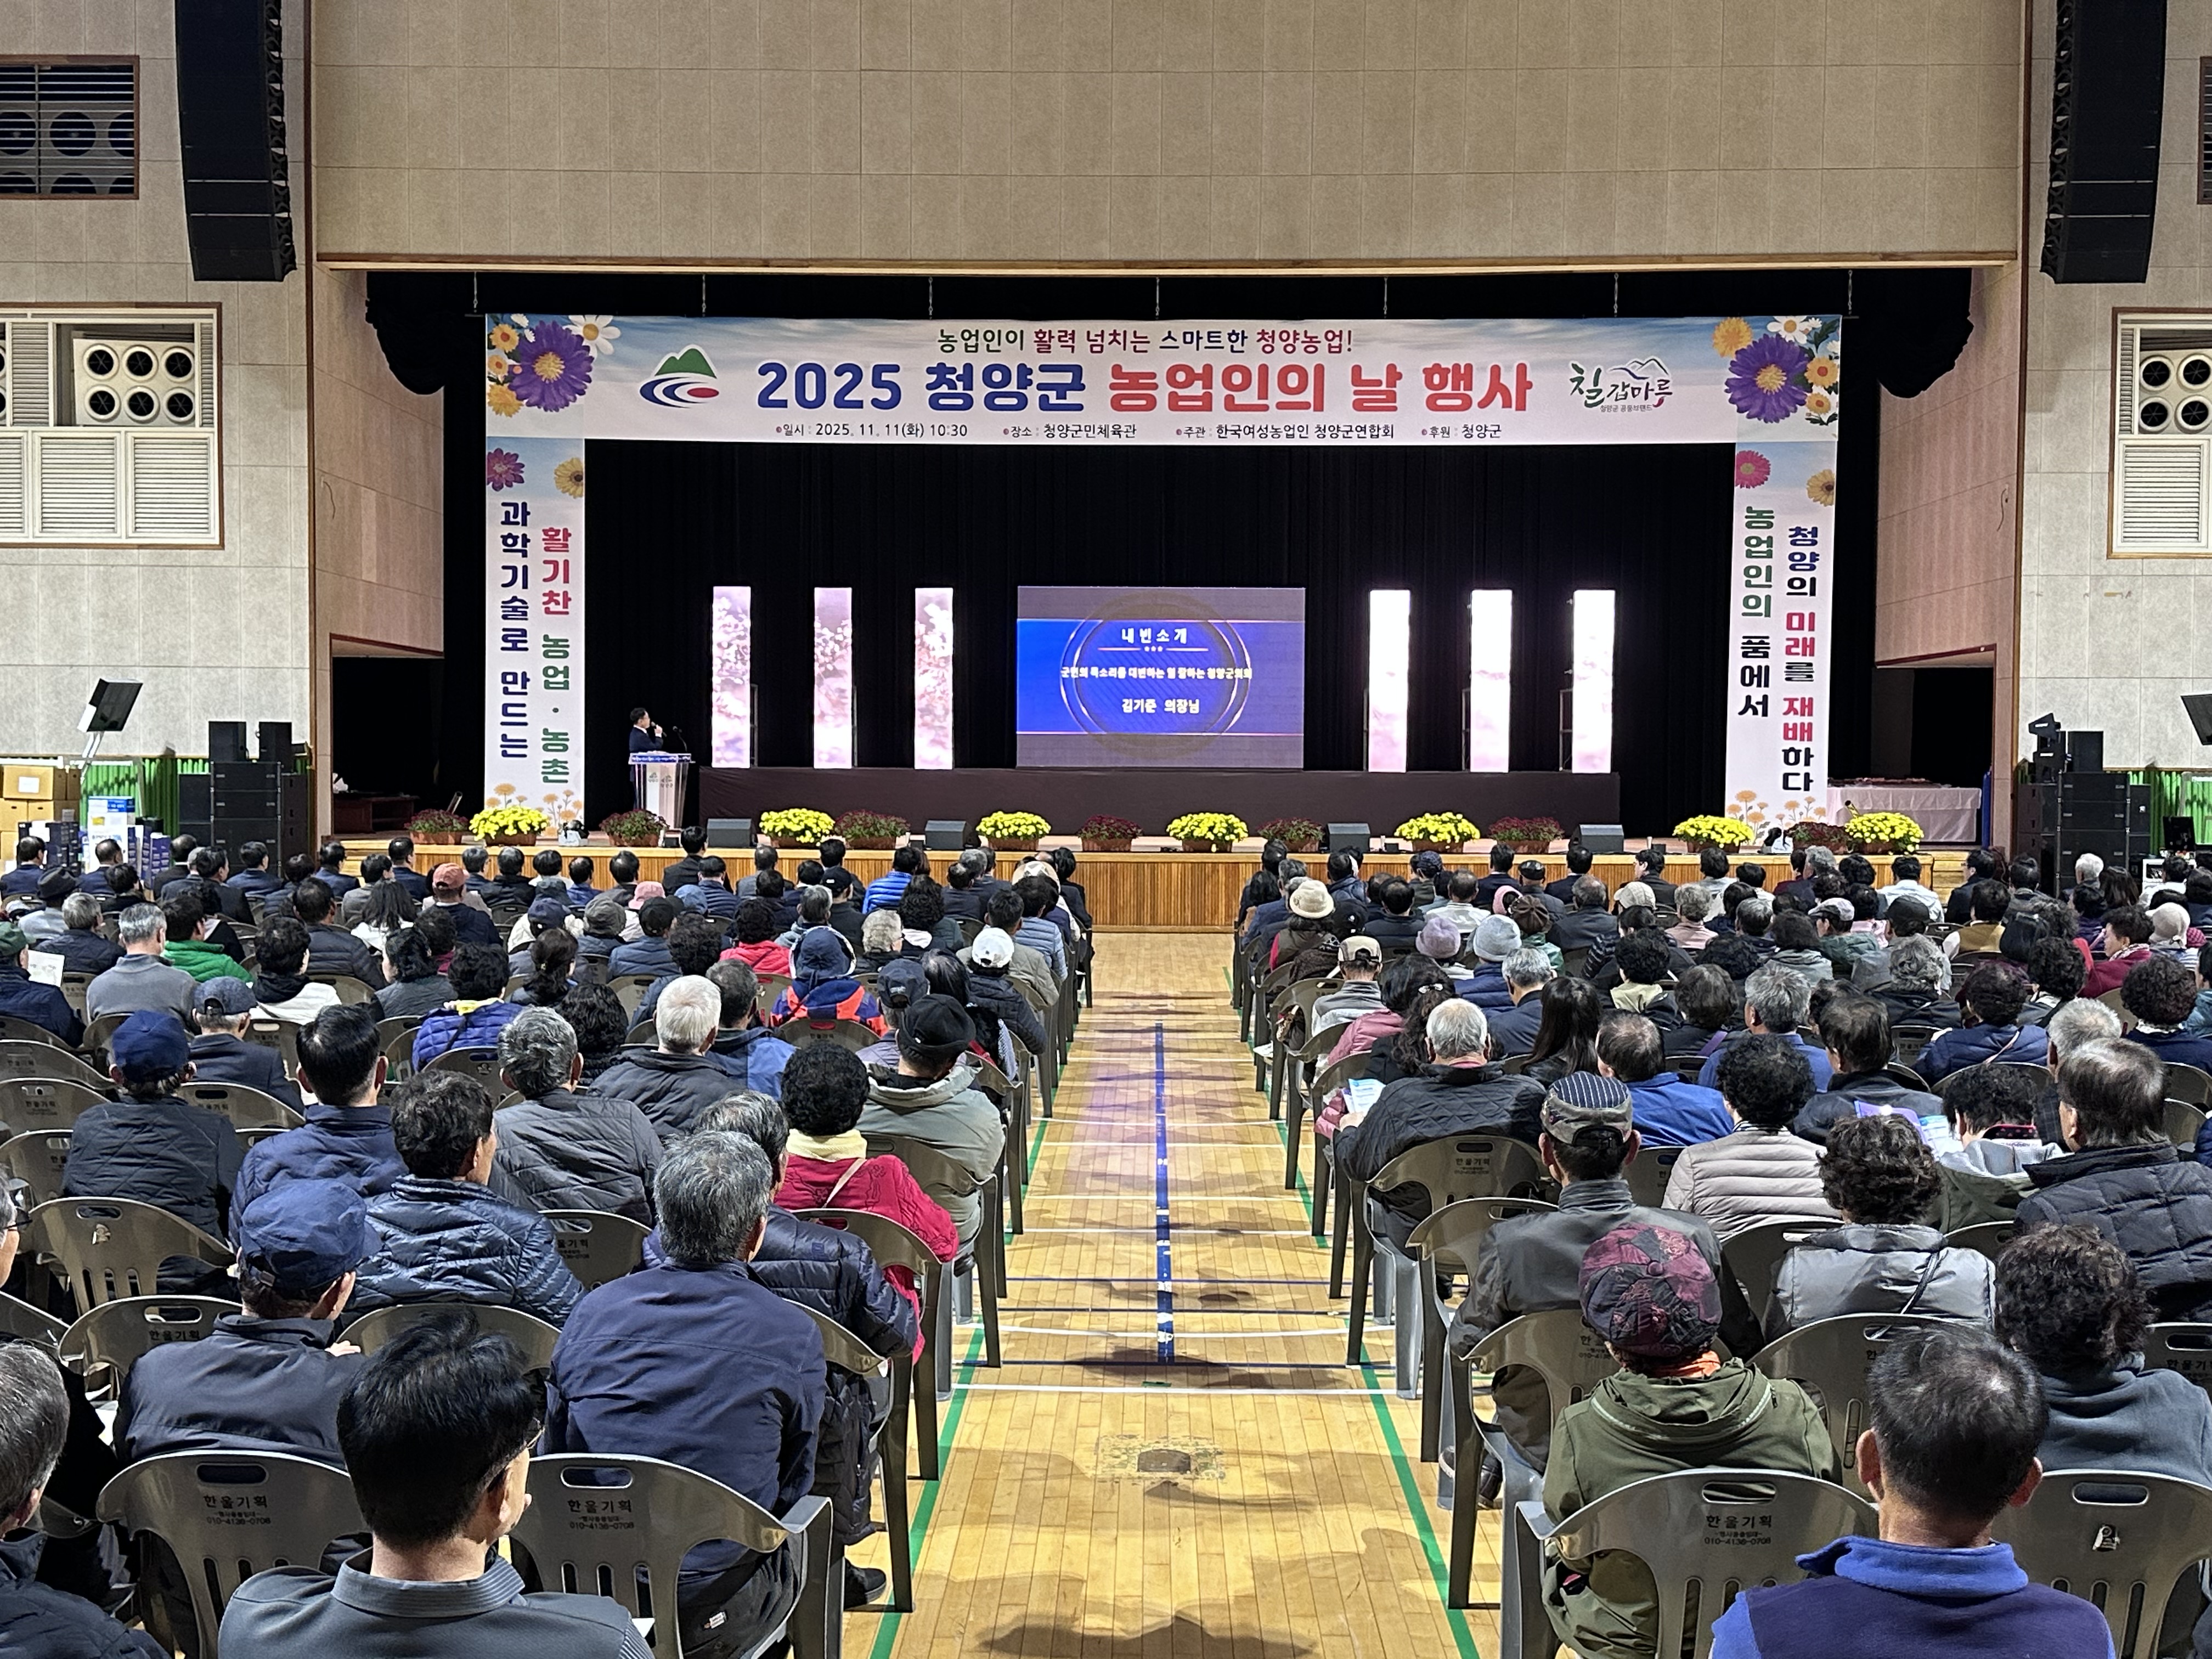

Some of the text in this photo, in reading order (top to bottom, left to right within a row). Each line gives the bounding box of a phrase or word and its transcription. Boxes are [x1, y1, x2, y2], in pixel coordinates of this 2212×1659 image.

[938, 329, 1352, 354] 농업인이 활력 넘치는 스마트한 청양농업!
[758, 362, 1533, 411] 2025 청양군 농업인의 날 행사
[1569, 363, 1673, 408] 칠갑마루
[783, 424, 804, 437] 일시
[816, 424, 854, 437] 2025.
[860, 424, 880, 437] 11.
[885, 423, 924, 438] 11(화)
[930, 424, 968, 437] 10:30
[1010, 425, 1032, 438] 장소
[1043, 424, 1137, 438] 청양군민체육관
[1183, 426, 1206, 438] 주관
[1216, 424, 1309, 439] 한국여성농업인
[1314, 424, 1394, 439] 청양군연합회
[1429, 426, 1451, 438] 후원
[1462, 424, 1502, 439] 청양군
[541, 527, 572, 616] 활기찬
[1738, 506, 1775, 718] 농업인의 품에서
[500, 501, 531, 758] 과학기술로 만드는
[1781, 526, 1820, 792] 청양의 미래를 재배하다
[203, 1495, 268, 1509] 한울기획
[567, 1499, 632, 1514] 한울기획
[1706, 1515, 1772, 1529] 한울기획
